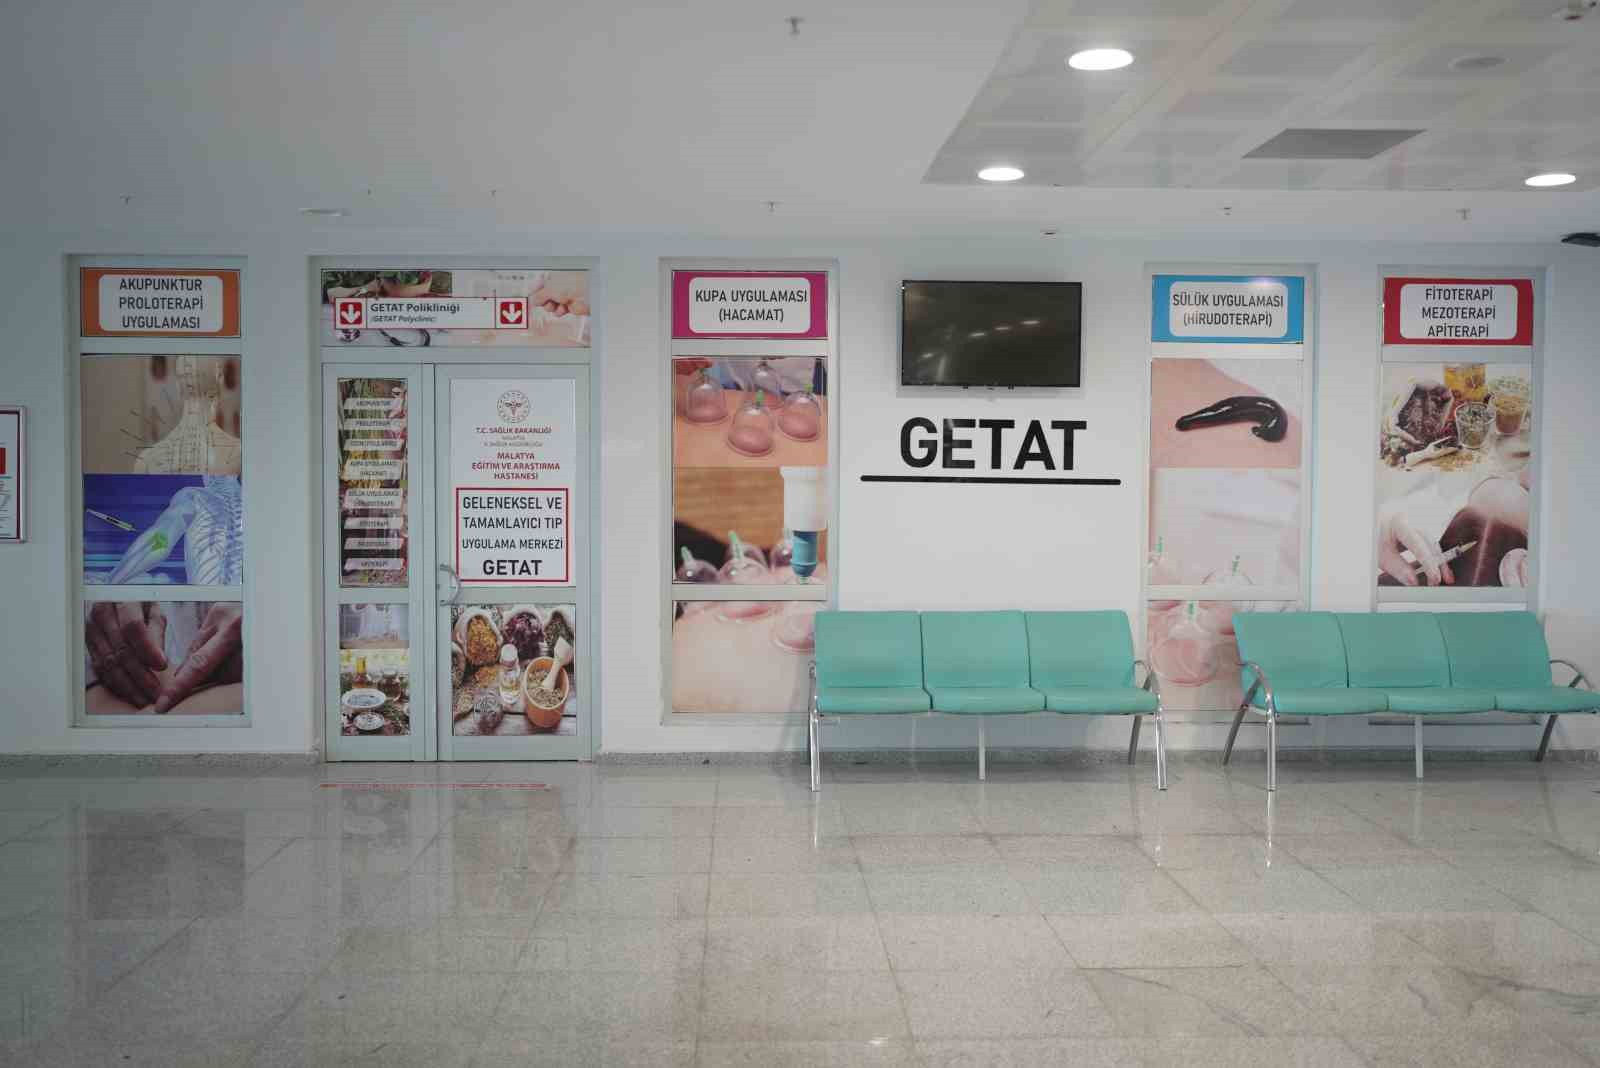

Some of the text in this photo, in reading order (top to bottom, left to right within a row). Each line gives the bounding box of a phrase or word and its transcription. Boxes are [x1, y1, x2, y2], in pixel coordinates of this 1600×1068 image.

[120, 278, 203, 291] AKUPUNKTUR
[695, 289, 807, 302] KUPA UYGULAMASI
[1172, 291, 1283, 307] SÜLÜK UYGULAMASI
[1425, 286, 1493, 301] FİTOTERAPİ
[119, 296, 203, 310] PROLOTERAPİ
[370, 303, 460, 314] GETAT Polikliniği
[719, 308, 784, 323] (HACAMAT)
[1183, 311, 1272, 327] (HİRUDOTERAPİ)
[1422, 305, 1496, 320] MEZOTERAPİ
[122, 316, 201, 329] UYGULAMASI
[1428, 323, 1489, 338] APİTERAPİ
[900, 416, 1088, 471] GETAT
[497, 452, 535, 460] MALATYA
[501, 462, 513, 470] VE
[463, 496, 563, 510] GELENEKSEL VE
[463, 517, 562, 529] TAMAMLAYICI TIP
[462, 538, 563, 550] UYGULAMA MERKEZİ
[482, 559, 543, 576] GETAT
